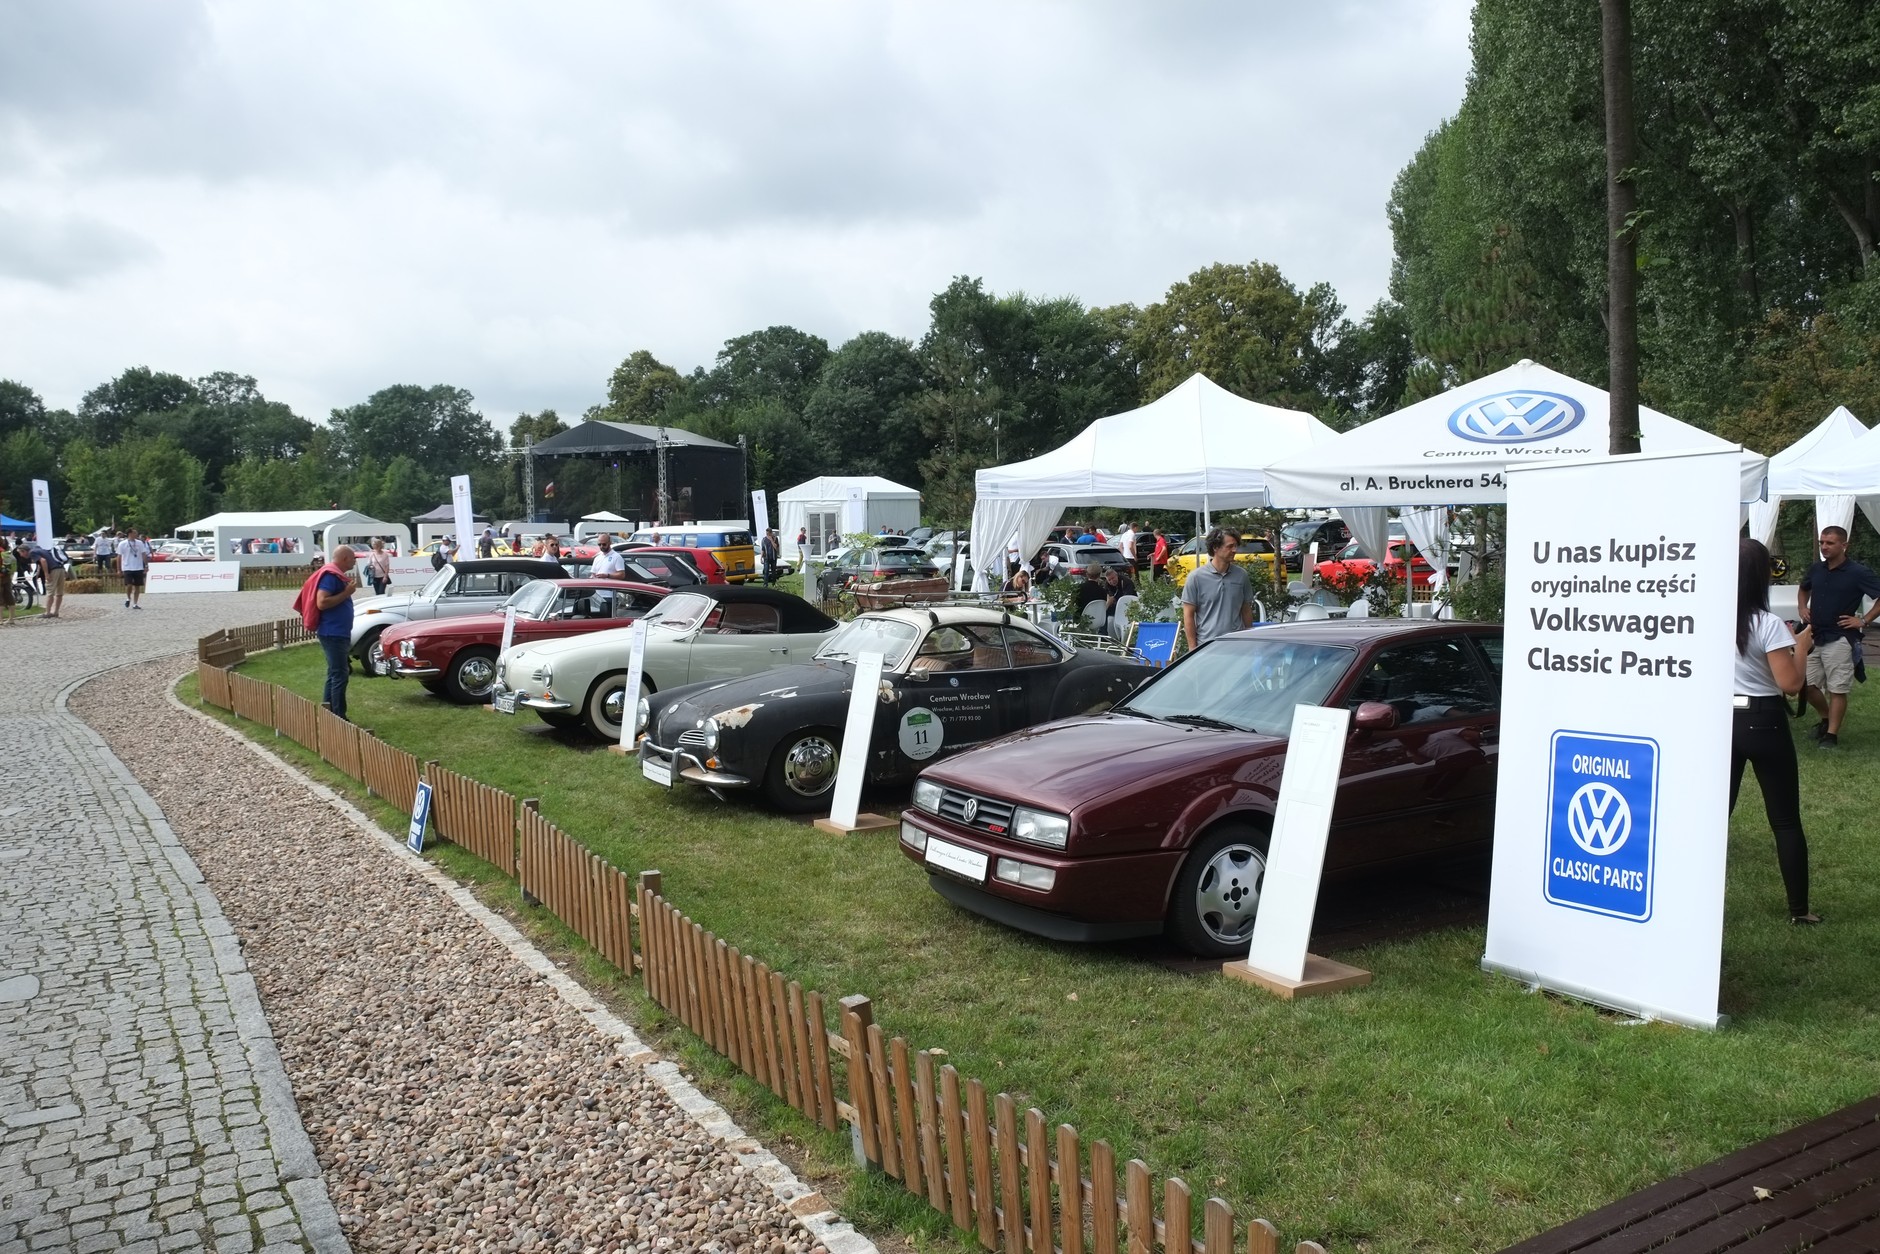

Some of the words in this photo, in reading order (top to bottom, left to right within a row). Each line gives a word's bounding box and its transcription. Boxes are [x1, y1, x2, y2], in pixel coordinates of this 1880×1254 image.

[1423, 449, 1497, 458] Centrum
[1505, 447, 1592, 455] Wrocław
[1340, 477, 1359, 491] al.
[1365, 477, 1383, 490] A.
[1389, 474, 1474, 490] Brucknera
[1480, 473, 1507, 490] 54,
[1533, 541, 1550, 564] U
[1557, 545, 1602, 563] nas
[1609, 535, 1696, 568] kupisz
[1531, 575, 1631, 598] oryginalne
[1636, 573, 1696, 598] części
[1530, 607, 1694, 640] Volkswagen
[1528, 647, 1612, 674] Classic
[1620, 651, 1692, 678] Parts
[960, 693, 990, 701] Wrocław
[914, 730, 928, 745] 11
[1572, 754, 1631, 779] ORIGINAL
[1553, 857, 1600, 884] CLASSIC
[1603, 866, 1643, 892] PARTS
